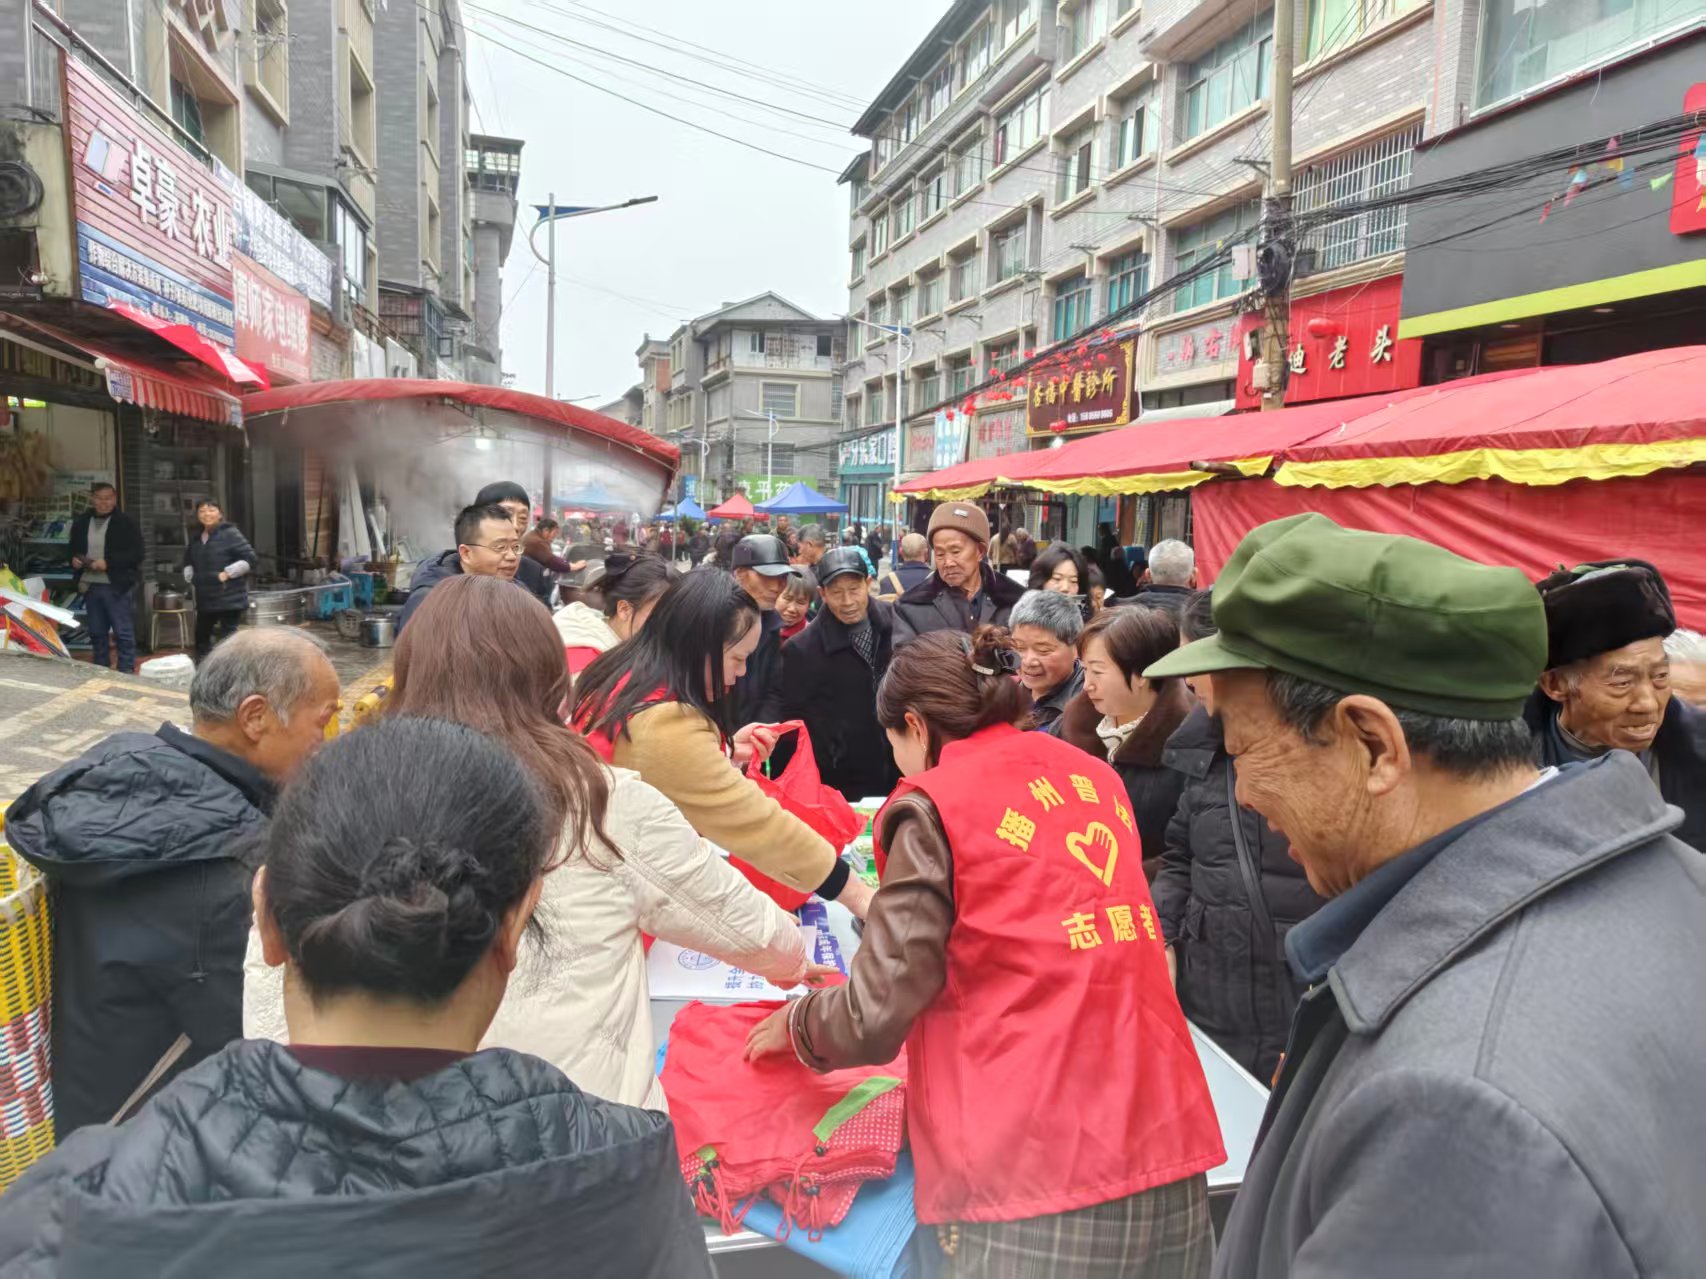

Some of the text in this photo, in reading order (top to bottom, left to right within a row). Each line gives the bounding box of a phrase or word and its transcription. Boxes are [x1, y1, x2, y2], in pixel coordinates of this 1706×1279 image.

[1255, 324, 1393, 375] 迪老头
[1060, 903, 1157, 951] 志愿者
